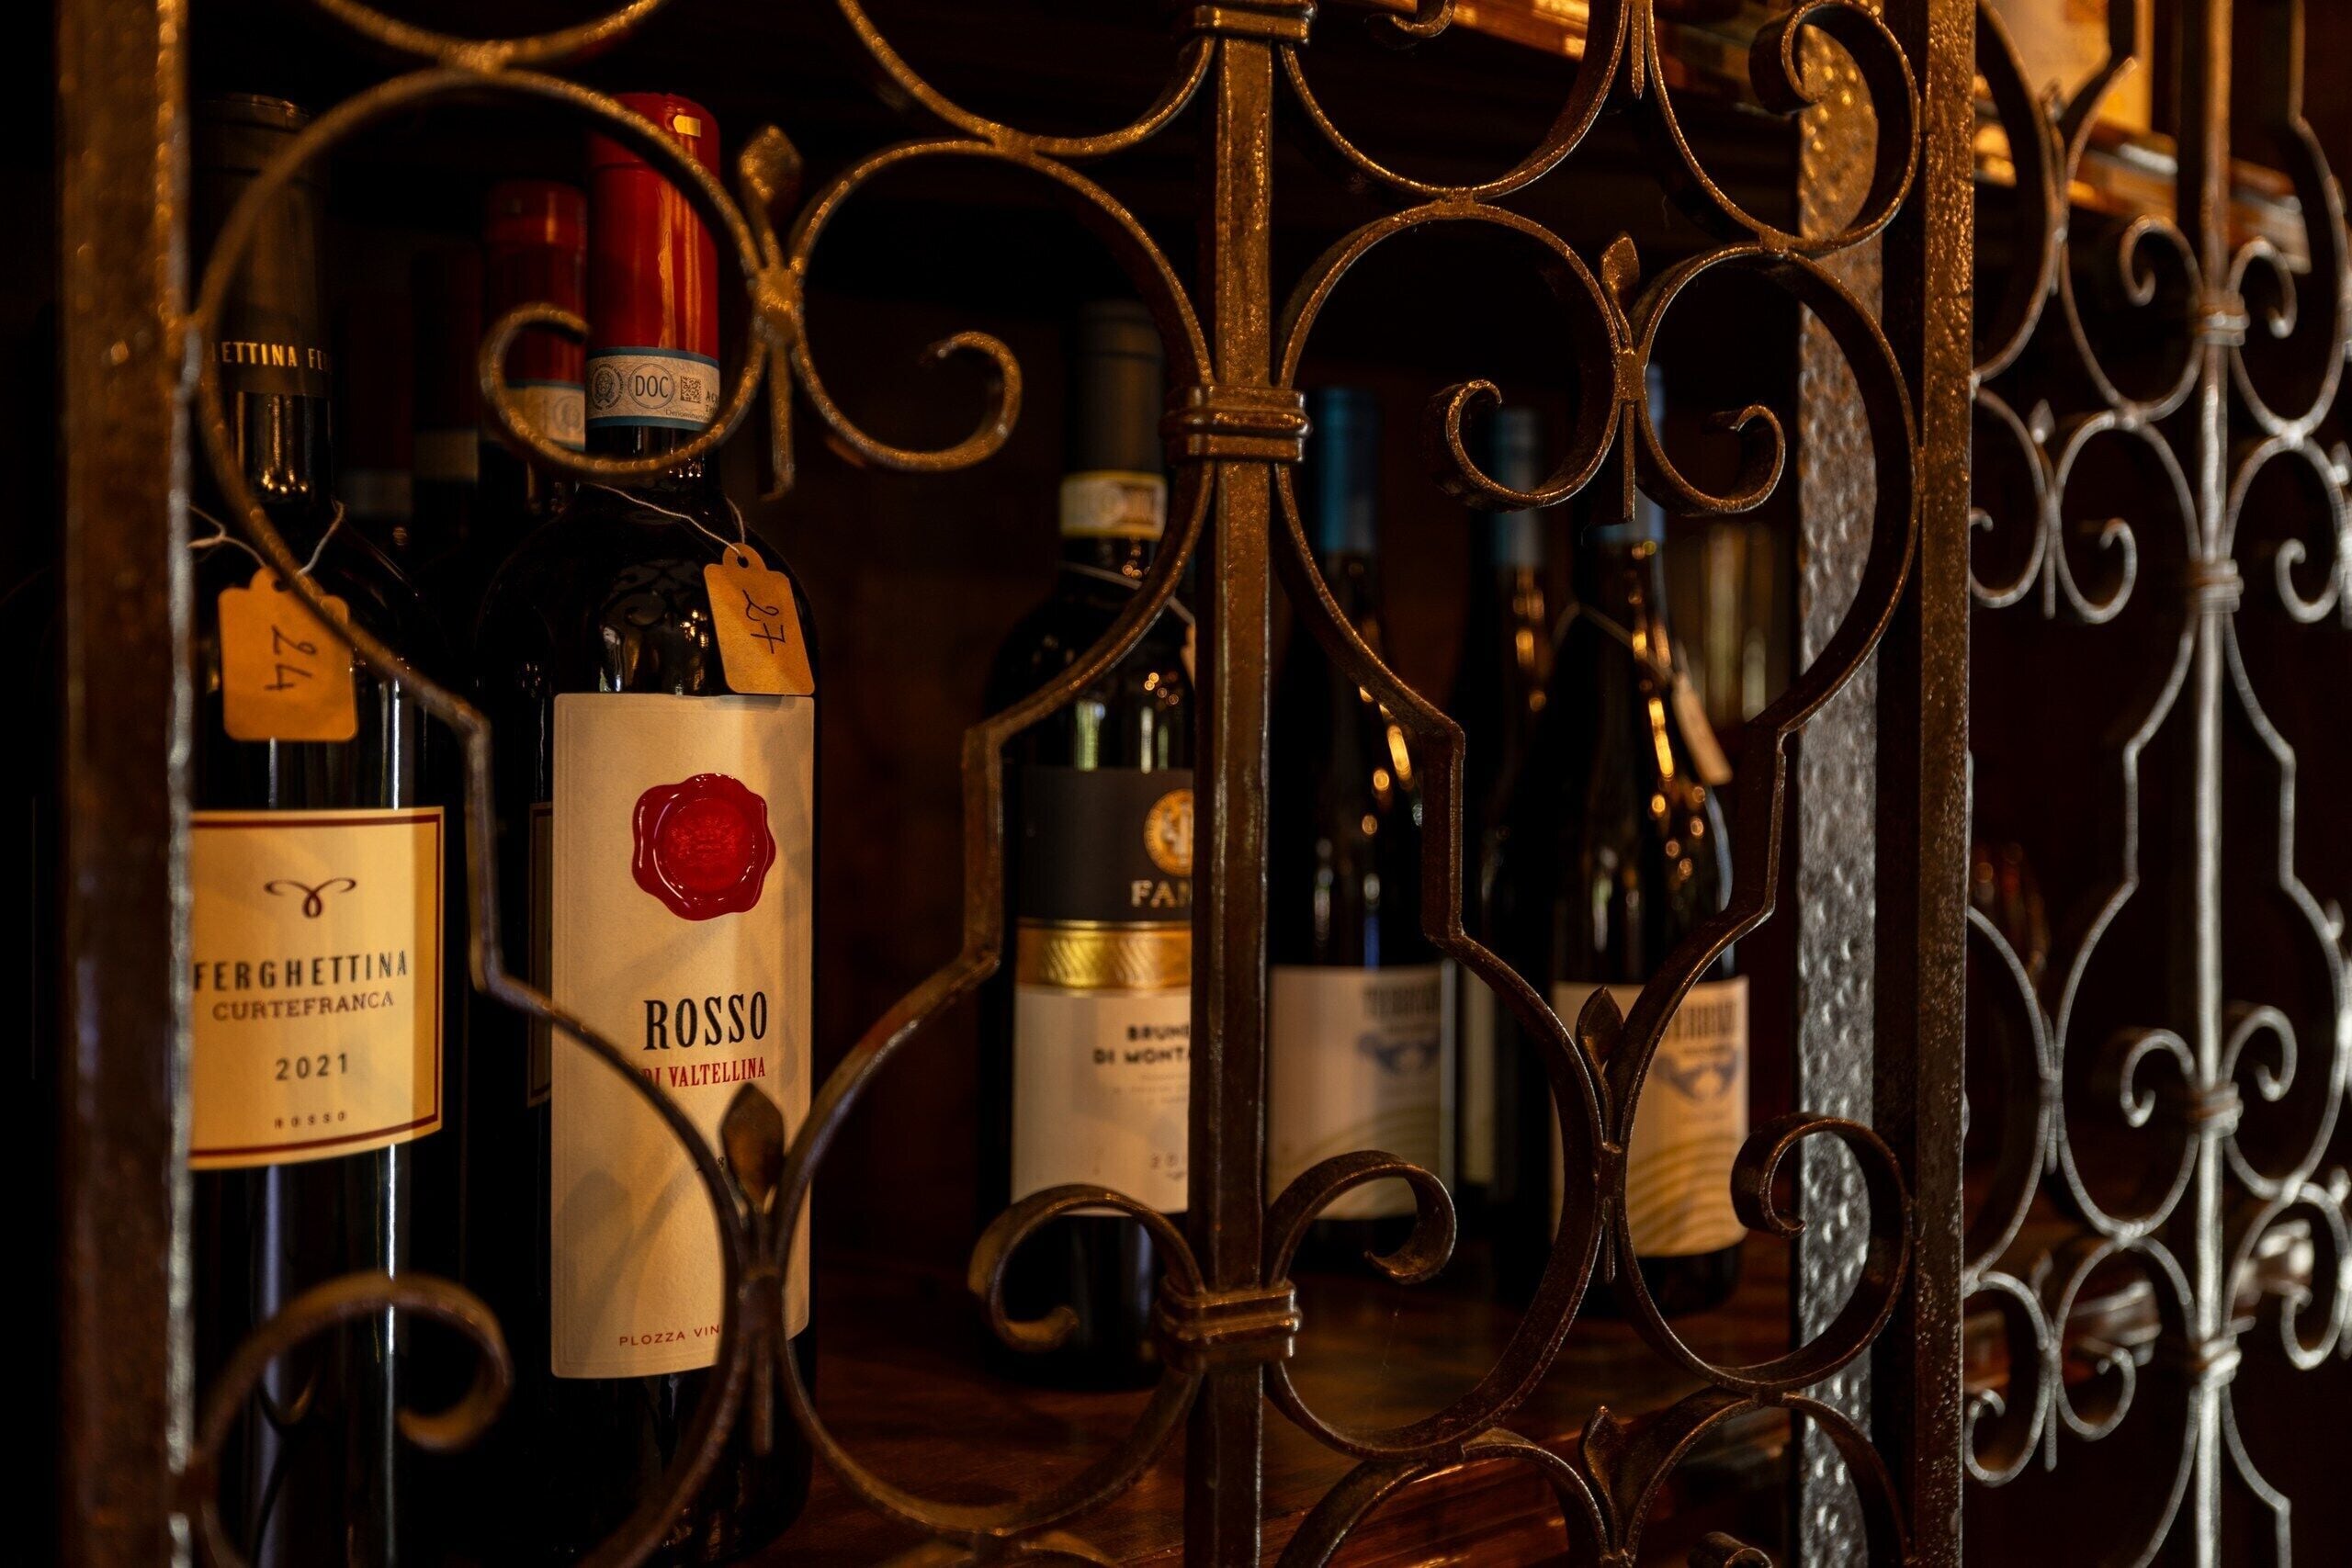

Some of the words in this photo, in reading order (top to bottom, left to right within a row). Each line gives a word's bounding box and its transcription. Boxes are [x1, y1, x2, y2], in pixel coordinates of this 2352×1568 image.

[635, 375, 669, 399] DOC
[742, 588, 786, 655] 27
[265, 625, 318, 691] 24
[193, 950, 408, 992] FERGHETTINA
[212, 989, 395, 1022] CURTEFRANCA
[643, 991, 768, 1051] ROSSO
[275, 1052, 349, 1081] 2021
[1093, 1049, 1115, 1065] DI
[1124, 1045, 1191, 1065] MONT
[668, 1056, 766, 1088] VALTELLINA
[274, 1111, 347, 1130] ROSSO
[619, 1331, 685, 1347] PLOZZA
